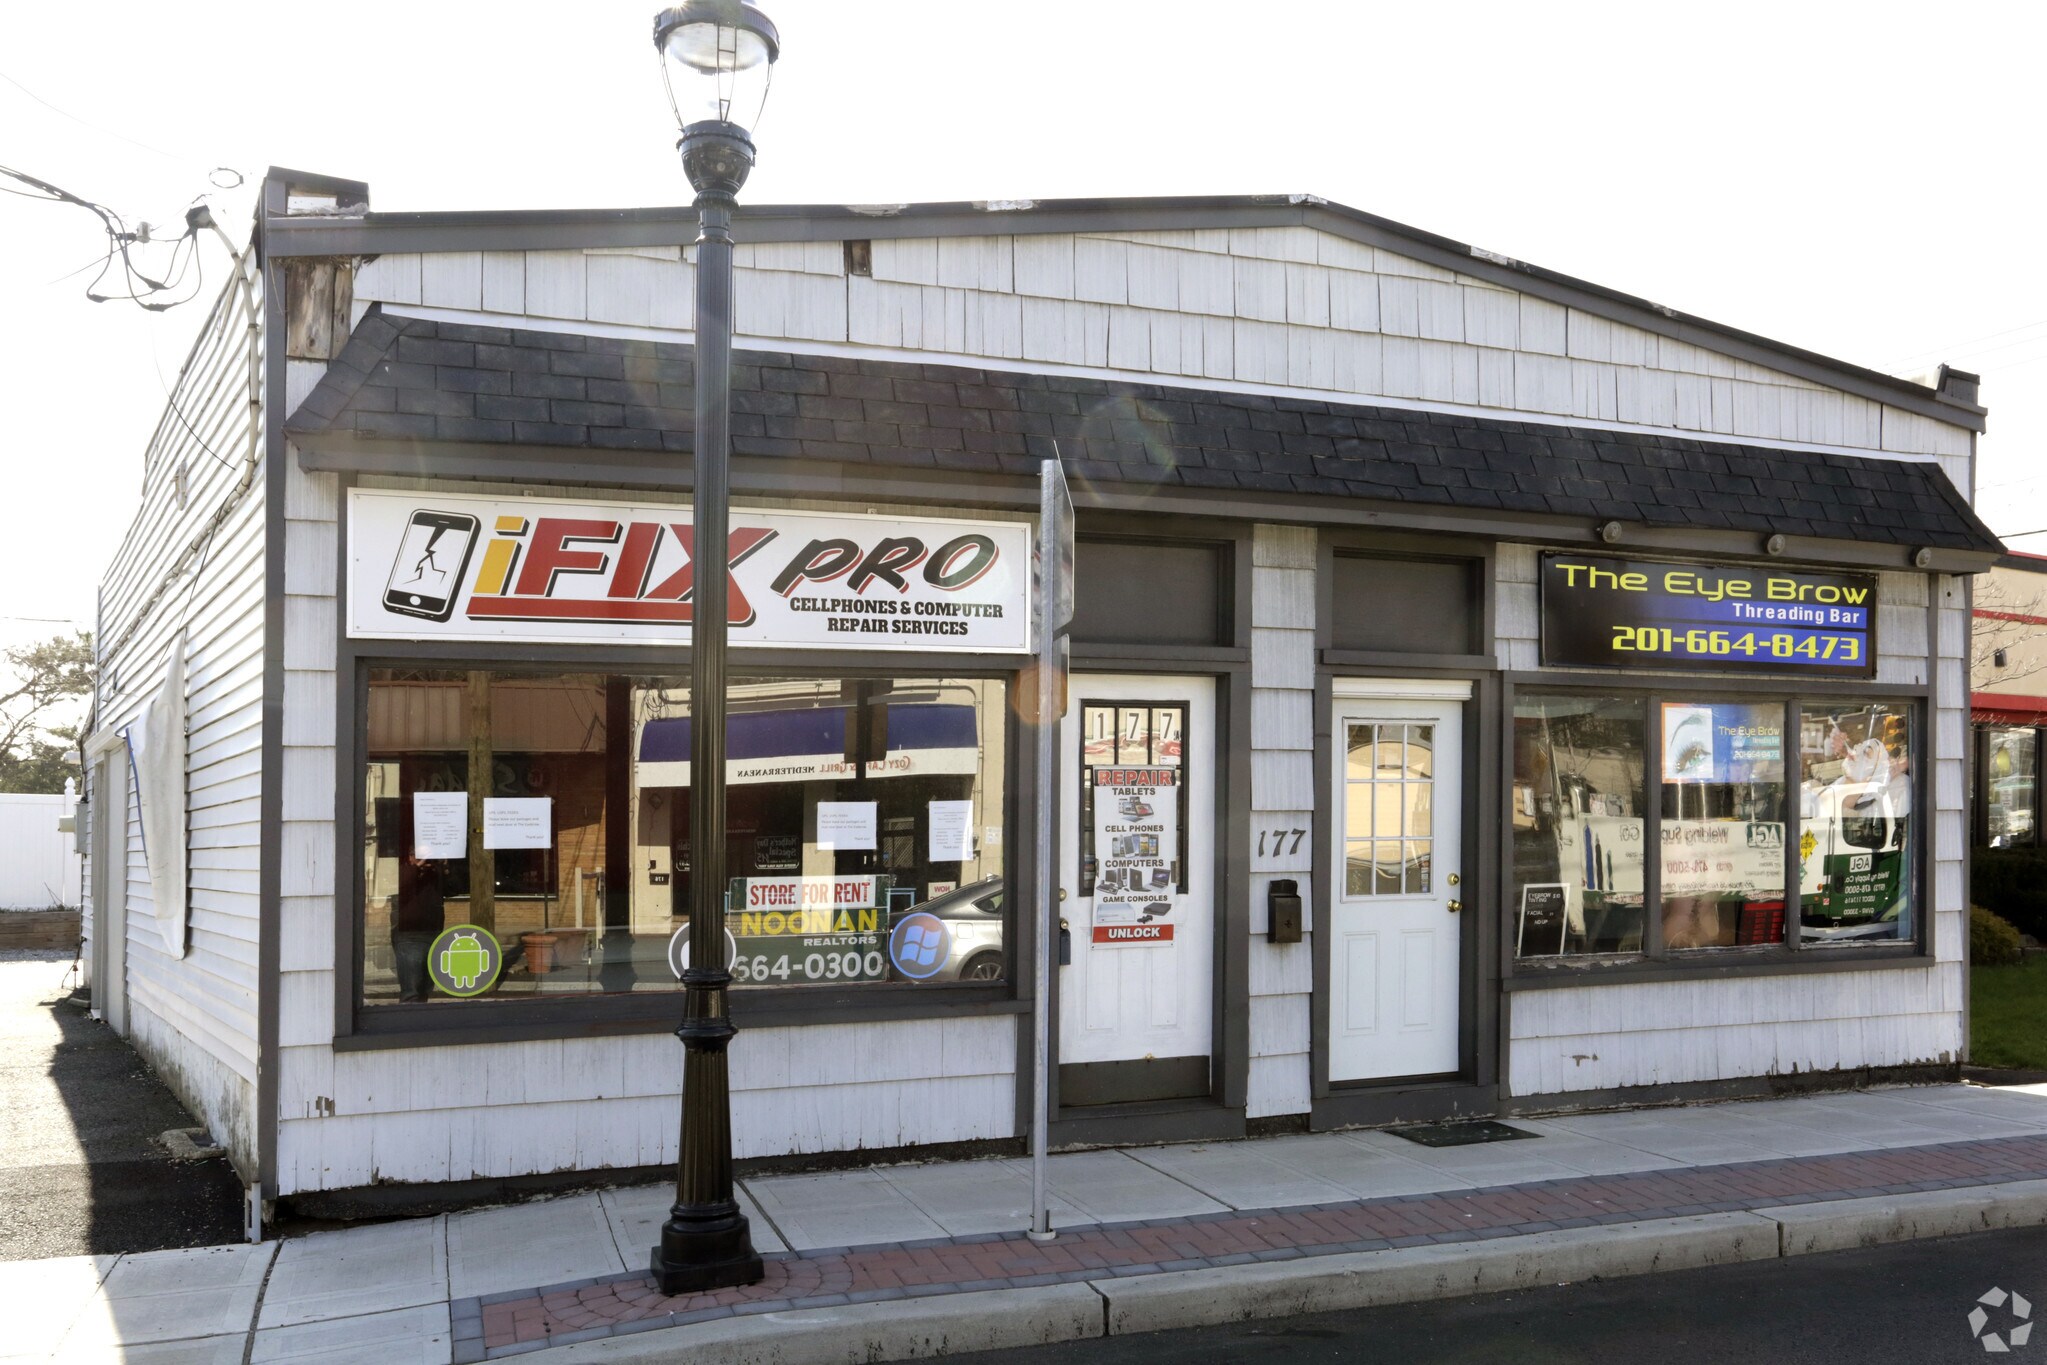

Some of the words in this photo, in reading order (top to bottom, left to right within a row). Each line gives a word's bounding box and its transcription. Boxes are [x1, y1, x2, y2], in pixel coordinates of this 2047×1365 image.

[769, 533, 1000, 599] PRO
[1555, 563, 1648, 592] The
[1664, 571, 1752, 601] Eye
[1767, 577, 1868, 605] Brow
[789, 596, 898, 615] CELLPHONES
[900, 600, 911, 615] &
[914, 601, 1003, 618] COMPUTER
[1732, 602, 1824, 625] Threading
[1829, 608, 1859, 624] Bar
[827, 617, 889, 633] REPAIR
[891, 619, 969, 636] SERVICES
[1612, 625, 1859, 661] 201-664-8473
[1097, 770, 1173, 786] REPAIR
[1112, 787, 1156, 796] TABLETS
[1258, 828, 1307, 858] 177
[1105, 859, 1164, 868] COMPUTERS
[750, 884, 796, 906] STORE
[801, 883, 829, 904] FOR
[833, 882, 871, 903] RENT
[1103, 895, 1125, 903] GAME
[1127, 894, 1168, 903] CONSOLES
[740, 908, 878, 936] NOONAN
[1108, 927, 1161, 939] UNLOCK
[803, 935, 878, 947] REALTORS
